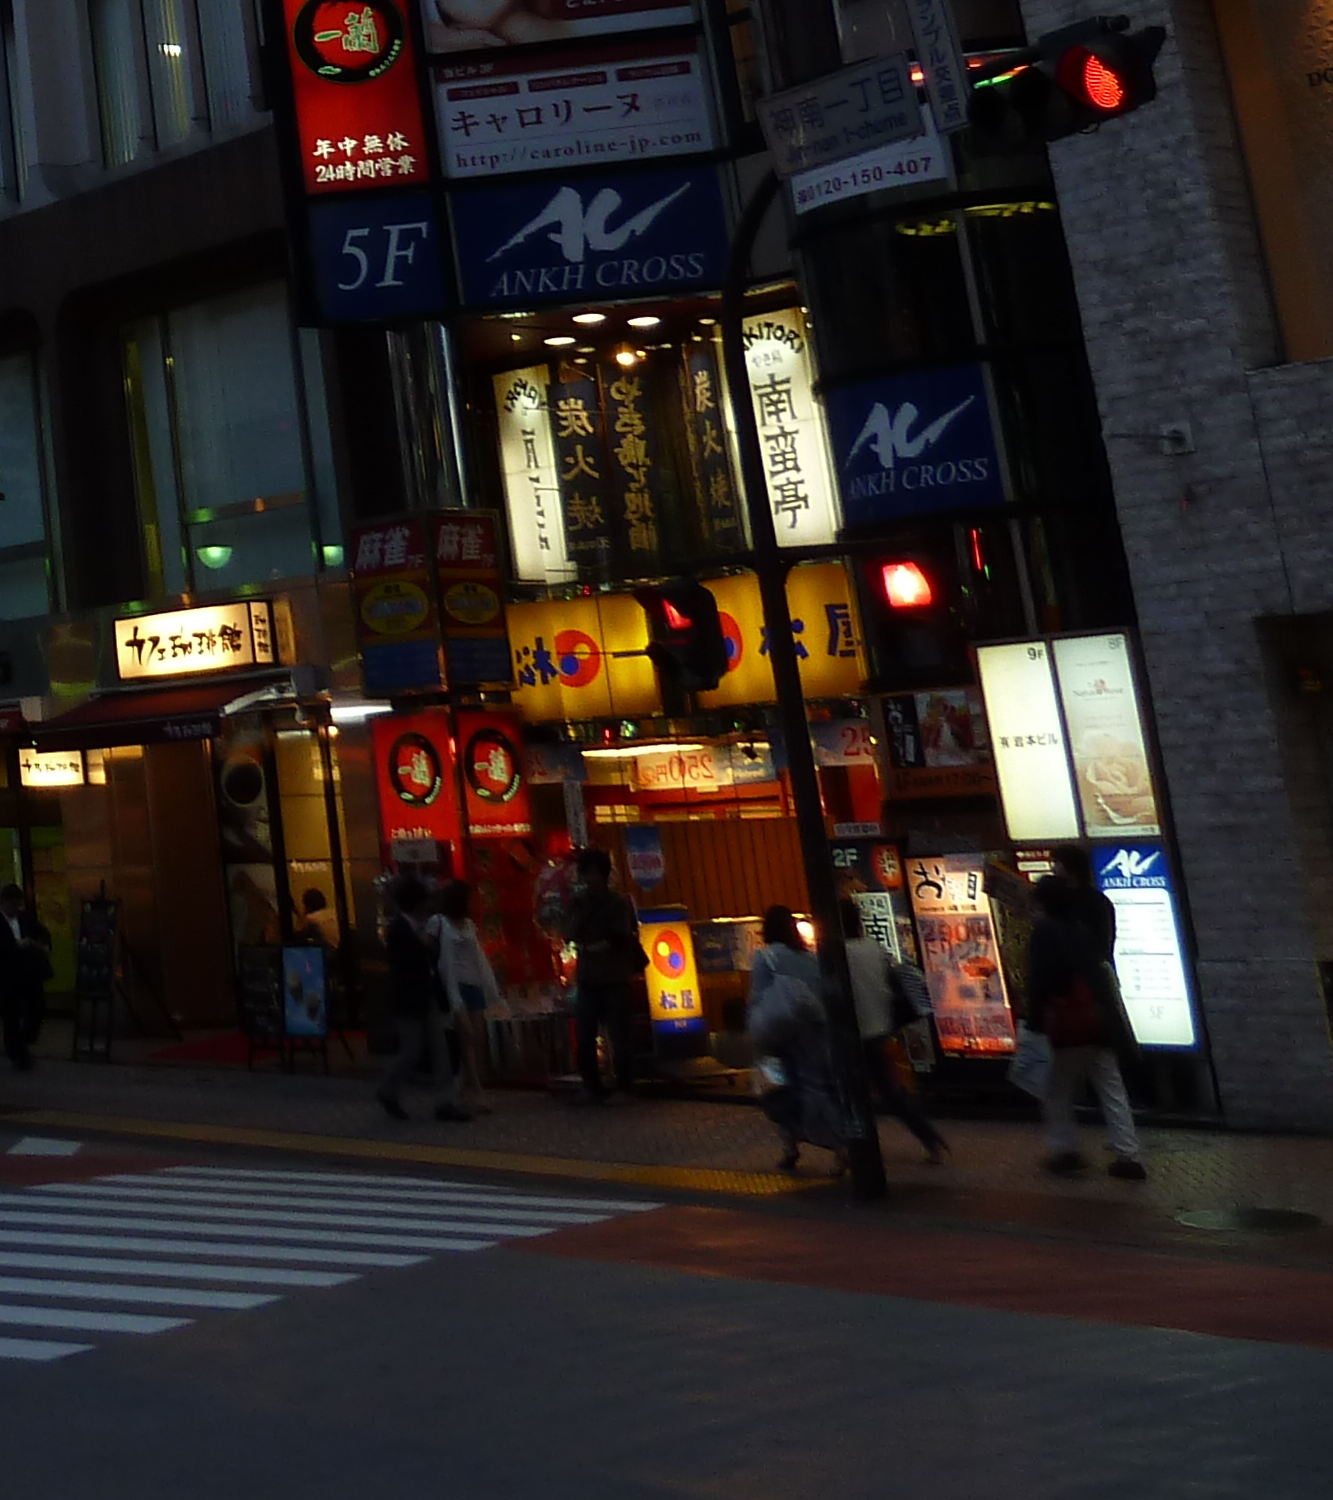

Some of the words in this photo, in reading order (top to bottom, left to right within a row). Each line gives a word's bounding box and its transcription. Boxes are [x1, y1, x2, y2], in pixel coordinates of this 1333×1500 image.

[314, 6, 381, 54] 一蘭
[451, 92, 641, 137] キャロリーヌ
[312, 130, 409, 159] 年中無休
[315, 153, 417, 184] 24時間営業
[337, 222, 428, 290] 5F
[490, 264, 586, 298] ANKH
[595, 252, 705, 289] CROSS
[752, 373, 811, 529] 南蛮亭
[901, 457, 989, 489] CROSS
[1027, 647, 1044, 662] 9F
[832, 847, 859, 869] 2F
